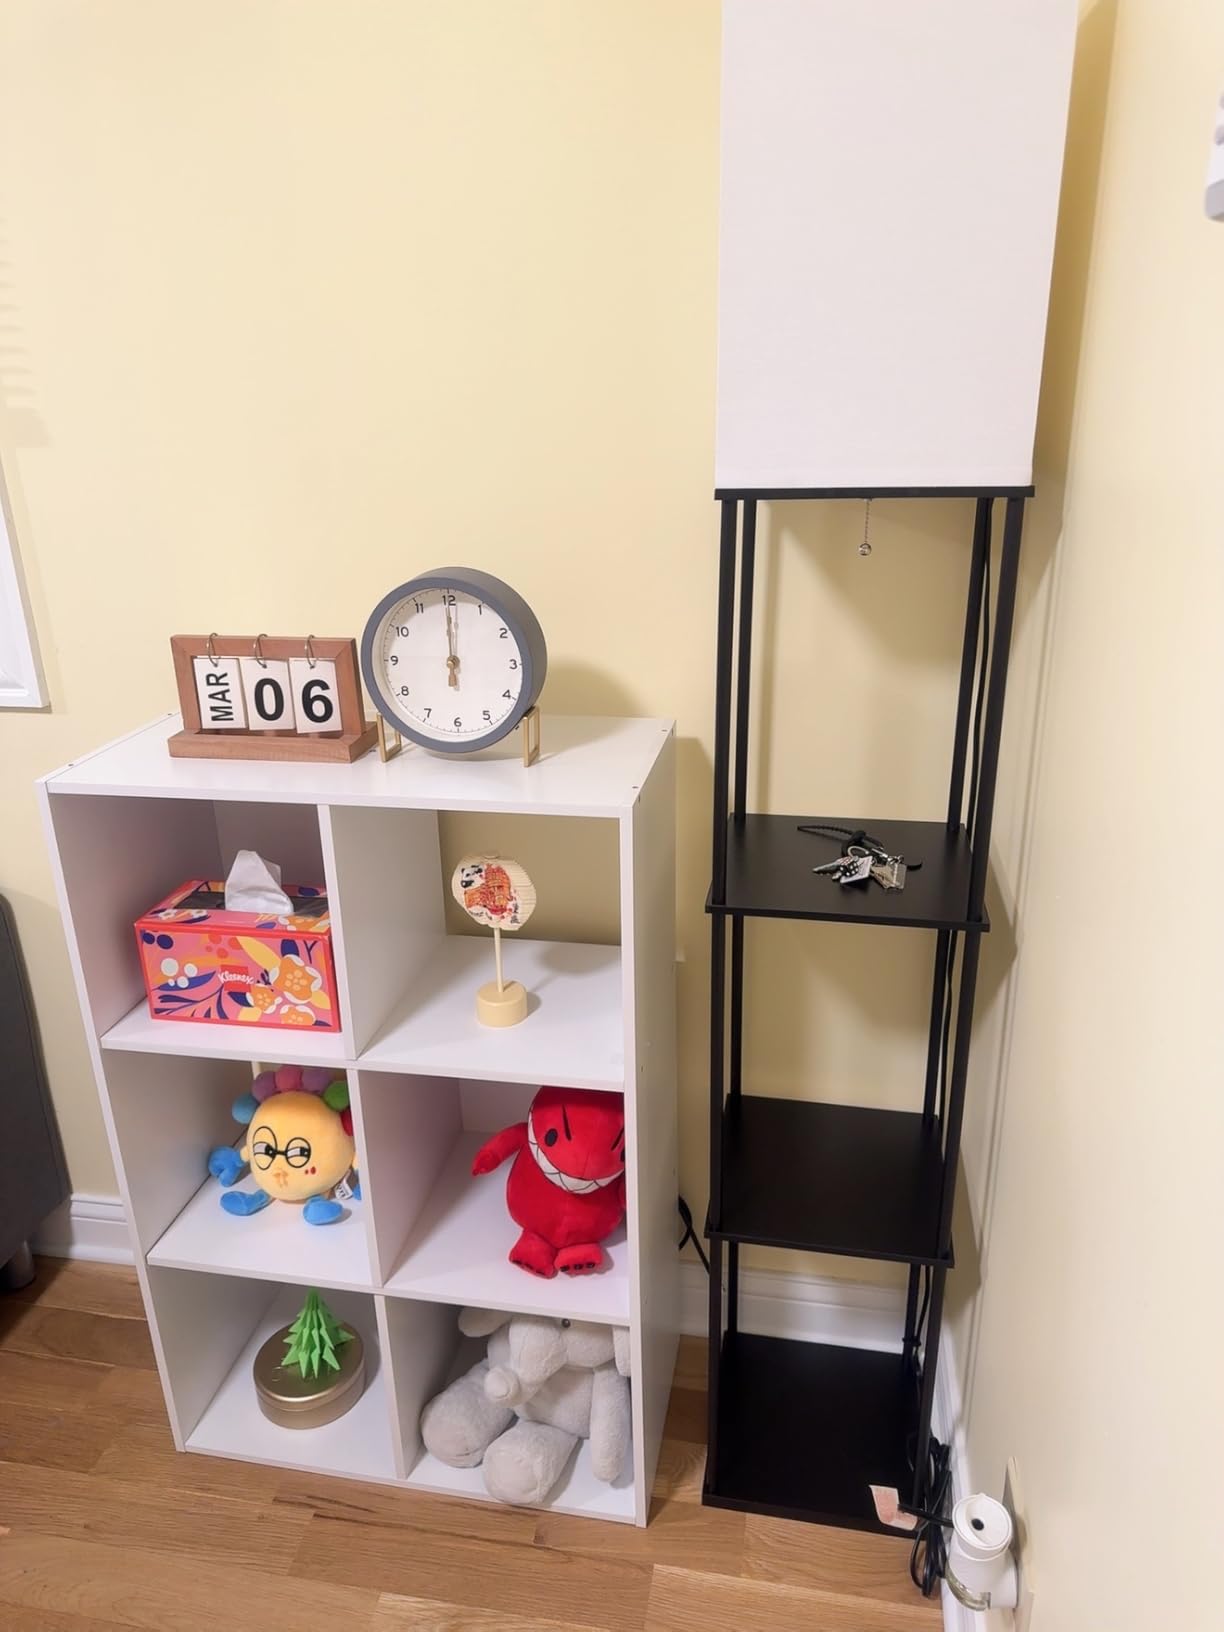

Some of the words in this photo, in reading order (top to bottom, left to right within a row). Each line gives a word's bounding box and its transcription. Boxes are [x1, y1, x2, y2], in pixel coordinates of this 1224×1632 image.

[442, 594, 456, 606] 12
[415, 603, 424, 614] 11
[477, 604, 483, 616] 1
[396, 626, 409, 637] 10
[499, 628, 508, 639] 2
[390, 655, 399, 666] 9
[509, 659, 518, 670] 3
[401, 685, 409, 696] 8
[502, 689, 511, 699] 4
[206, 672, 234, 722] MAR
[424, 708, 432, 719] 7
[482, 710, 491, 721] 5
[453, 717, 462, 727] 6
[218, 971, 254, 985] Kleenex
